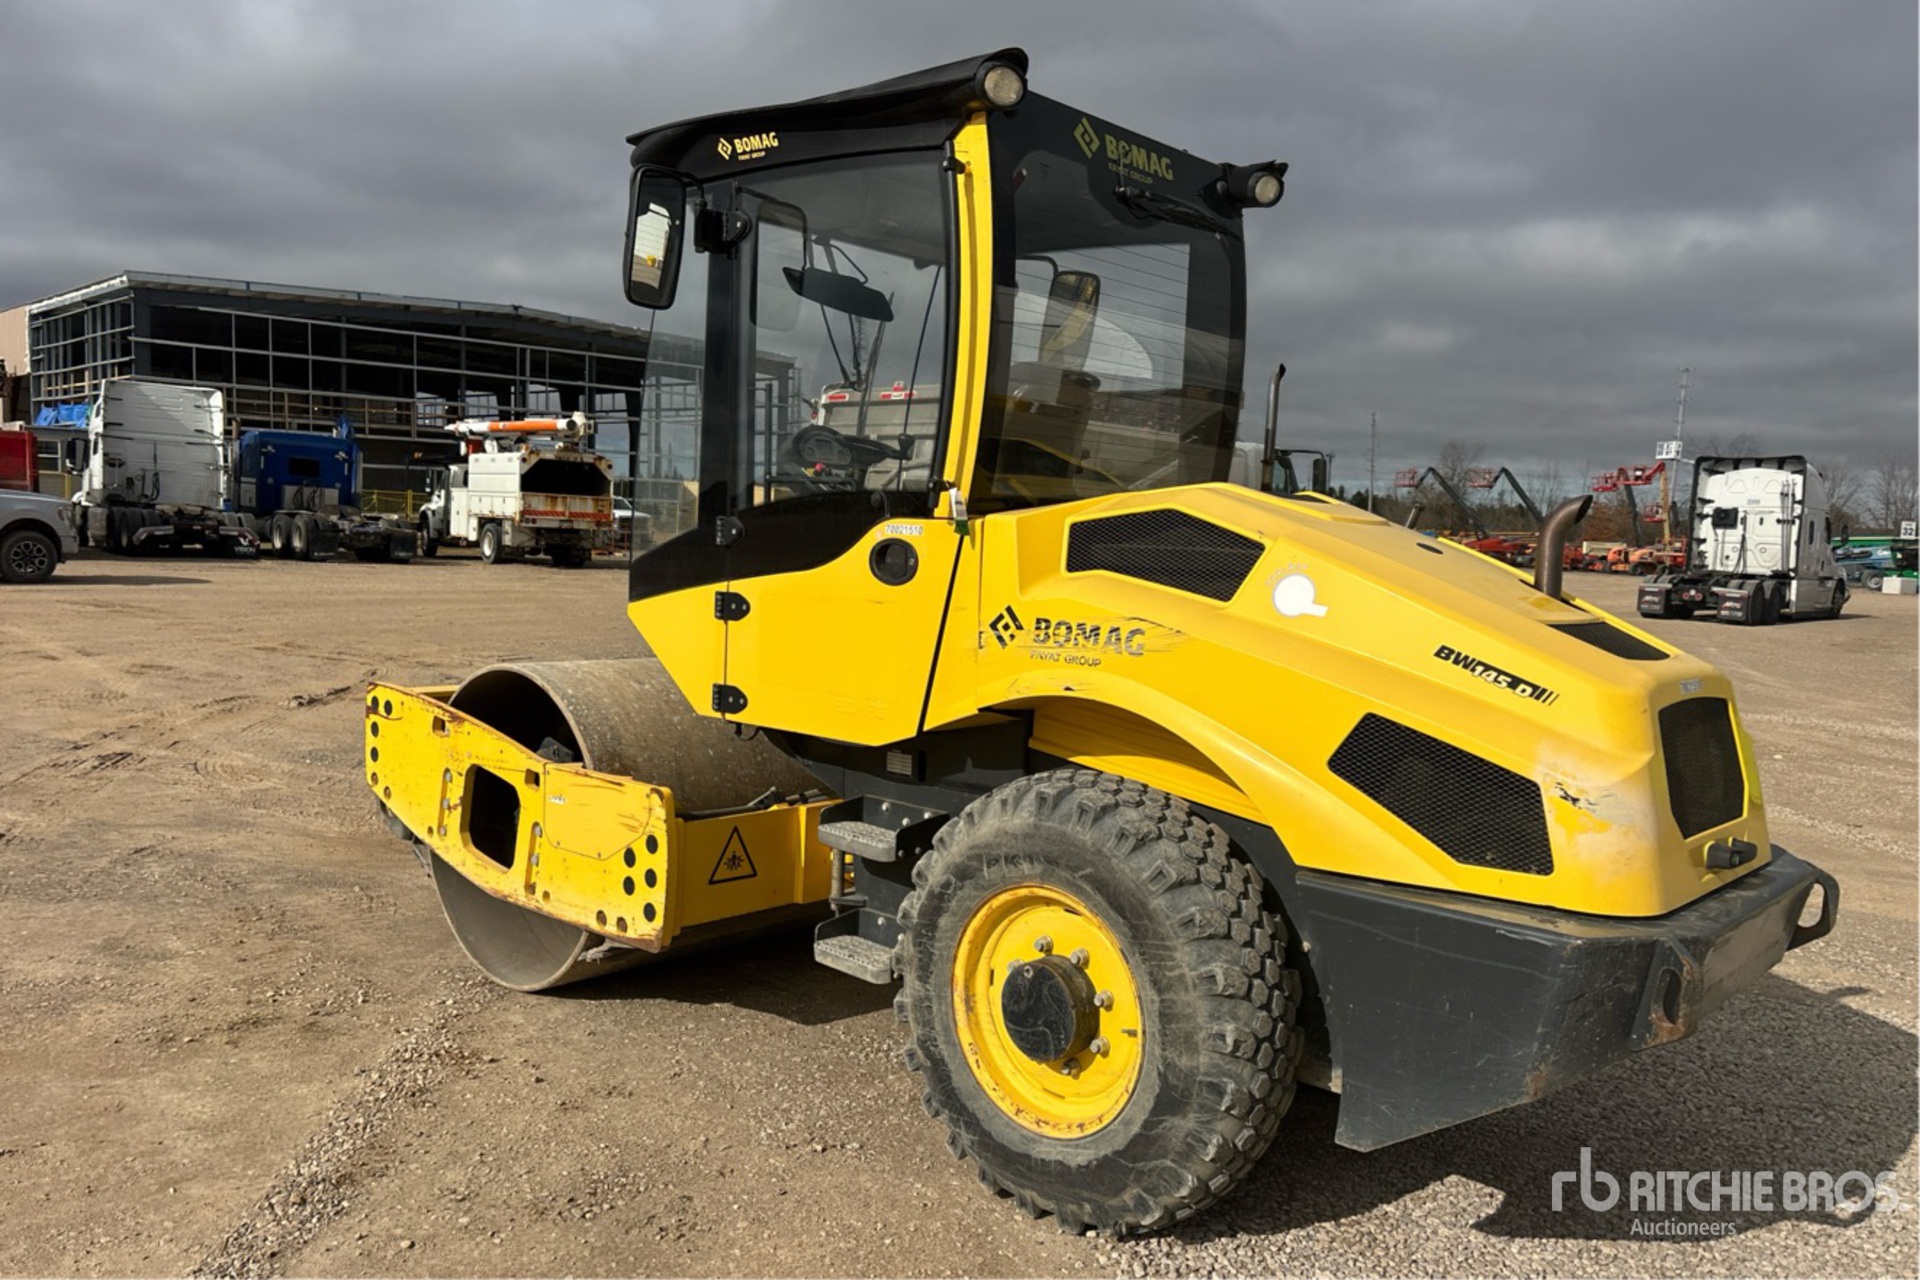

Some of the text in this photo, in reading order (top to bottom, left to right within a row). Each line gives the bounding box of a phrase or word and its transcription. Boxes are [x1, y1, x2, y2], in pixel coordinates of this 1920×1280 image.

[733, 131, 779, 154] BOMAG
[1104, 133, 1174, 181] BOMAG
[1902, 527, 1915, 537] 32
[1032, 616, 1146, 657] BOMAG
[1064, 653, 1102, 668] GROUP
